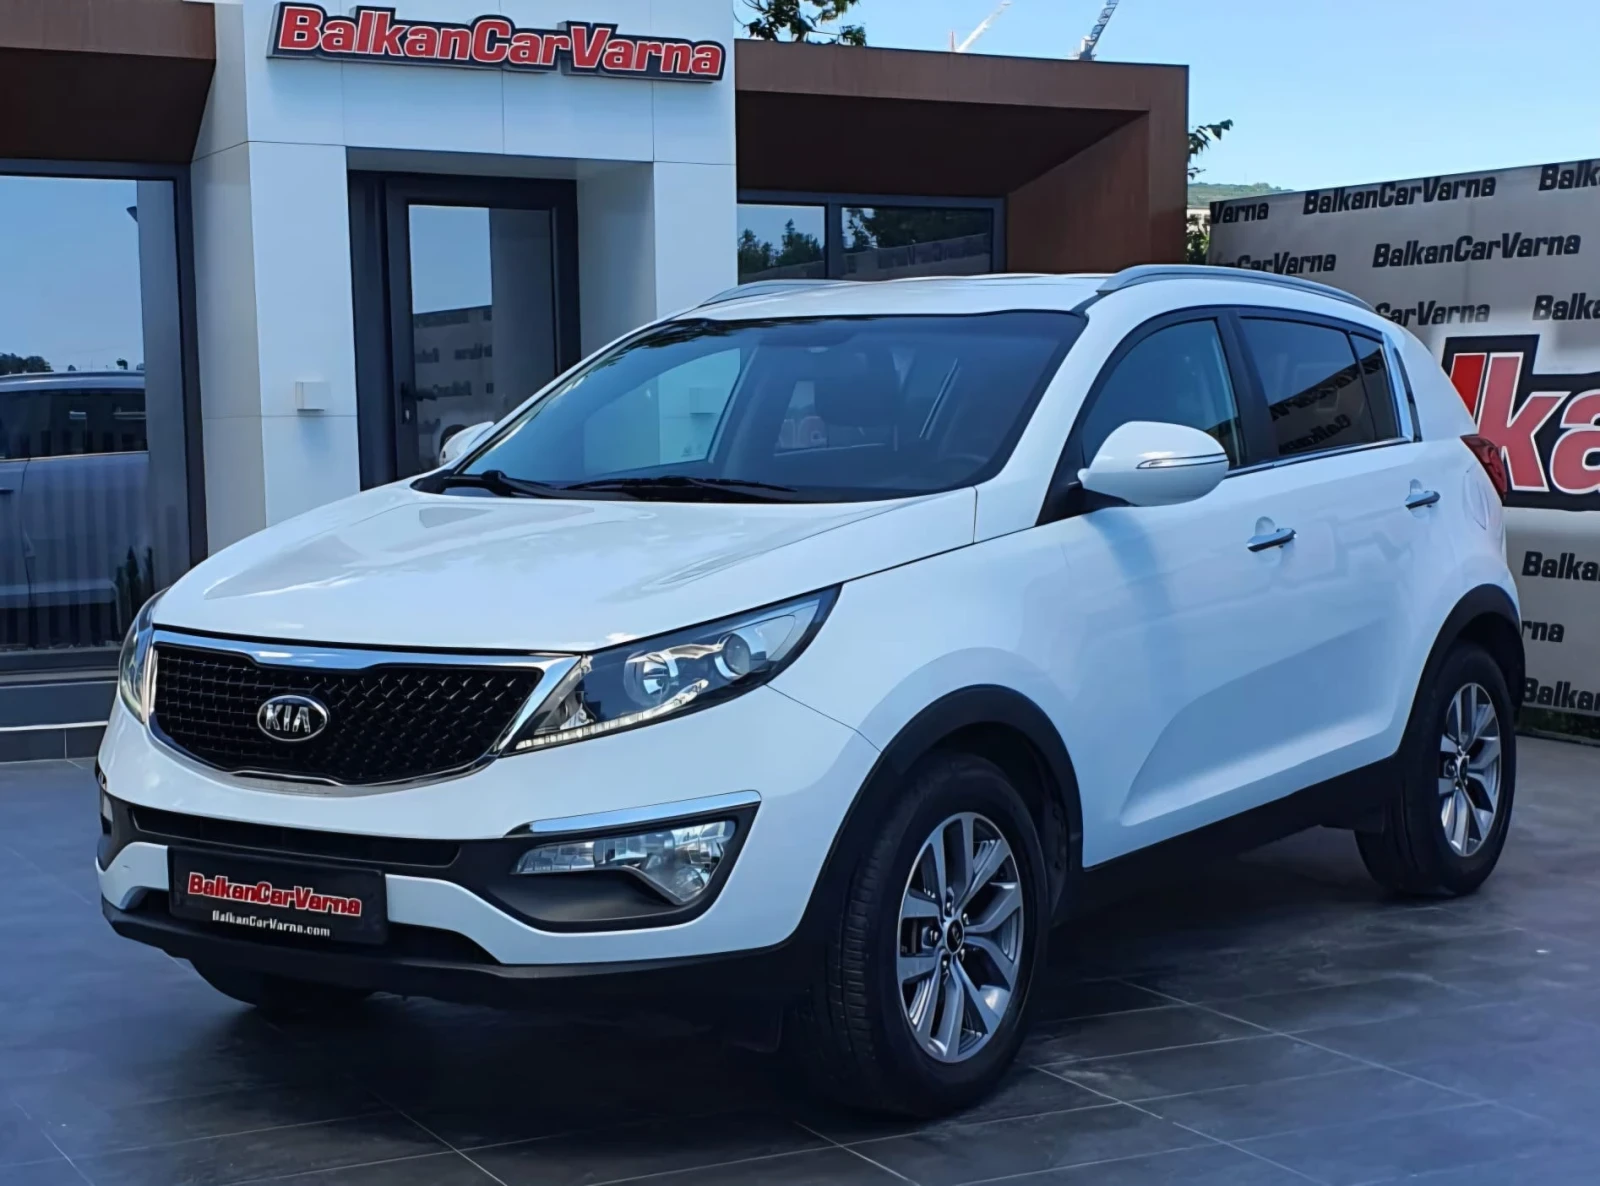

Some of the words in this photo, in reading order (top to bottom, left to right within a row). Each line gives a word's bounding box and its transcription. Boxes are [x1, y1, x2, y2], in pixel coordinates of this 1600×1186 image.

[278, 5, 723, 76] BalkanCarVarna
[1538, 159, 1600, 191] Balk
[1303, 176, 1497, 216] BalkanCarVarna
[1372, 232, 1582, 268] BalkanCarVarna
[1522, 550, 1600, 582] Balka
[265, 704, 311, 733] KIA
[187, 871, 362, 917] BalkanCarVarna
[212, 910, 331, 937] BalkanCarVarna.com
